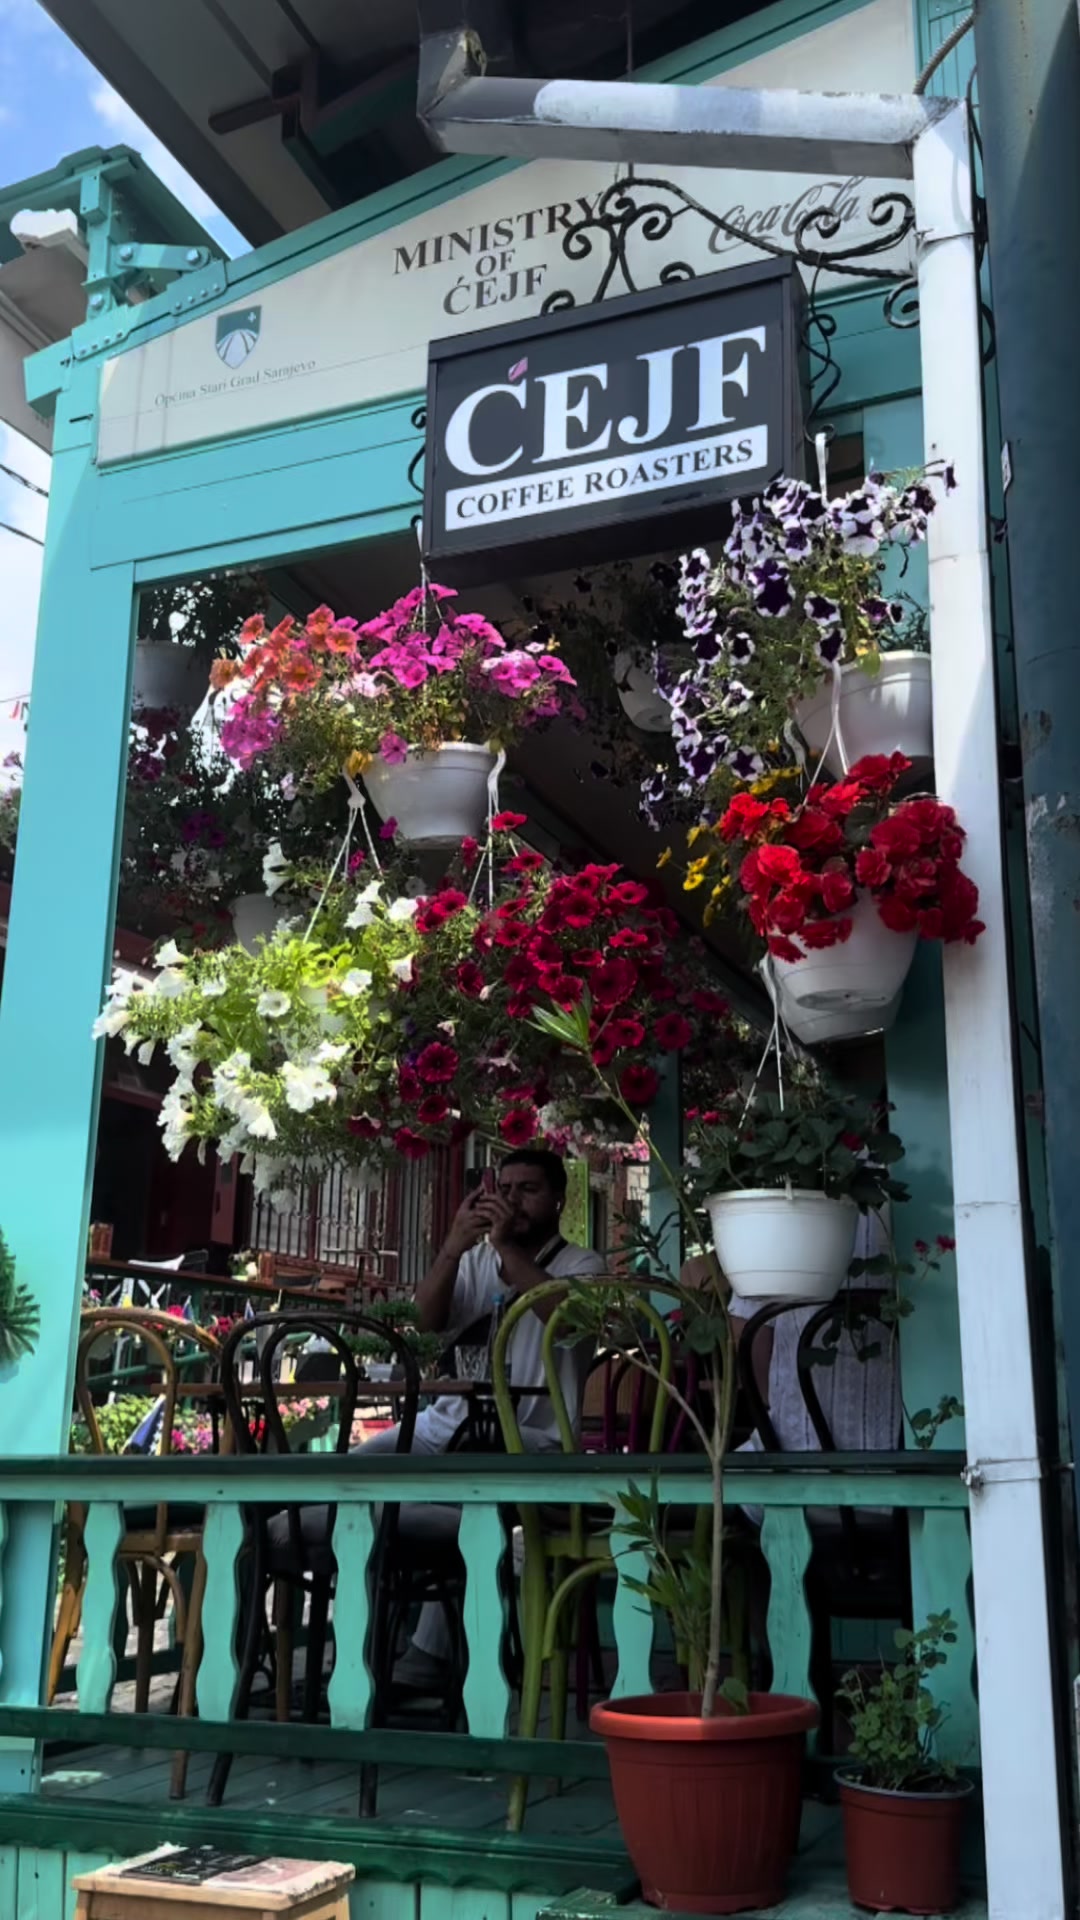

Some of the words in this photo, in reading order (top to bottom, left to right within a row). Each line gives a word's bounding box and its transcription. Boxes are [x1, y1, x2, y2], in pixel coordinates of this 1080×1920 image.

[392, 191, 602, 275] MINISTRY
[475, 249, 516, 276] OF
[443, 264, 548, 315] ĆEJF
[200, 379, 227, 395] Stari
[230, 371, 260, 388] Grad
[263, 359, 317, 379] Sarajevo
[456, 477, 574, 518] COFFEE
[585, 438, 753, 495] ROASTERS
